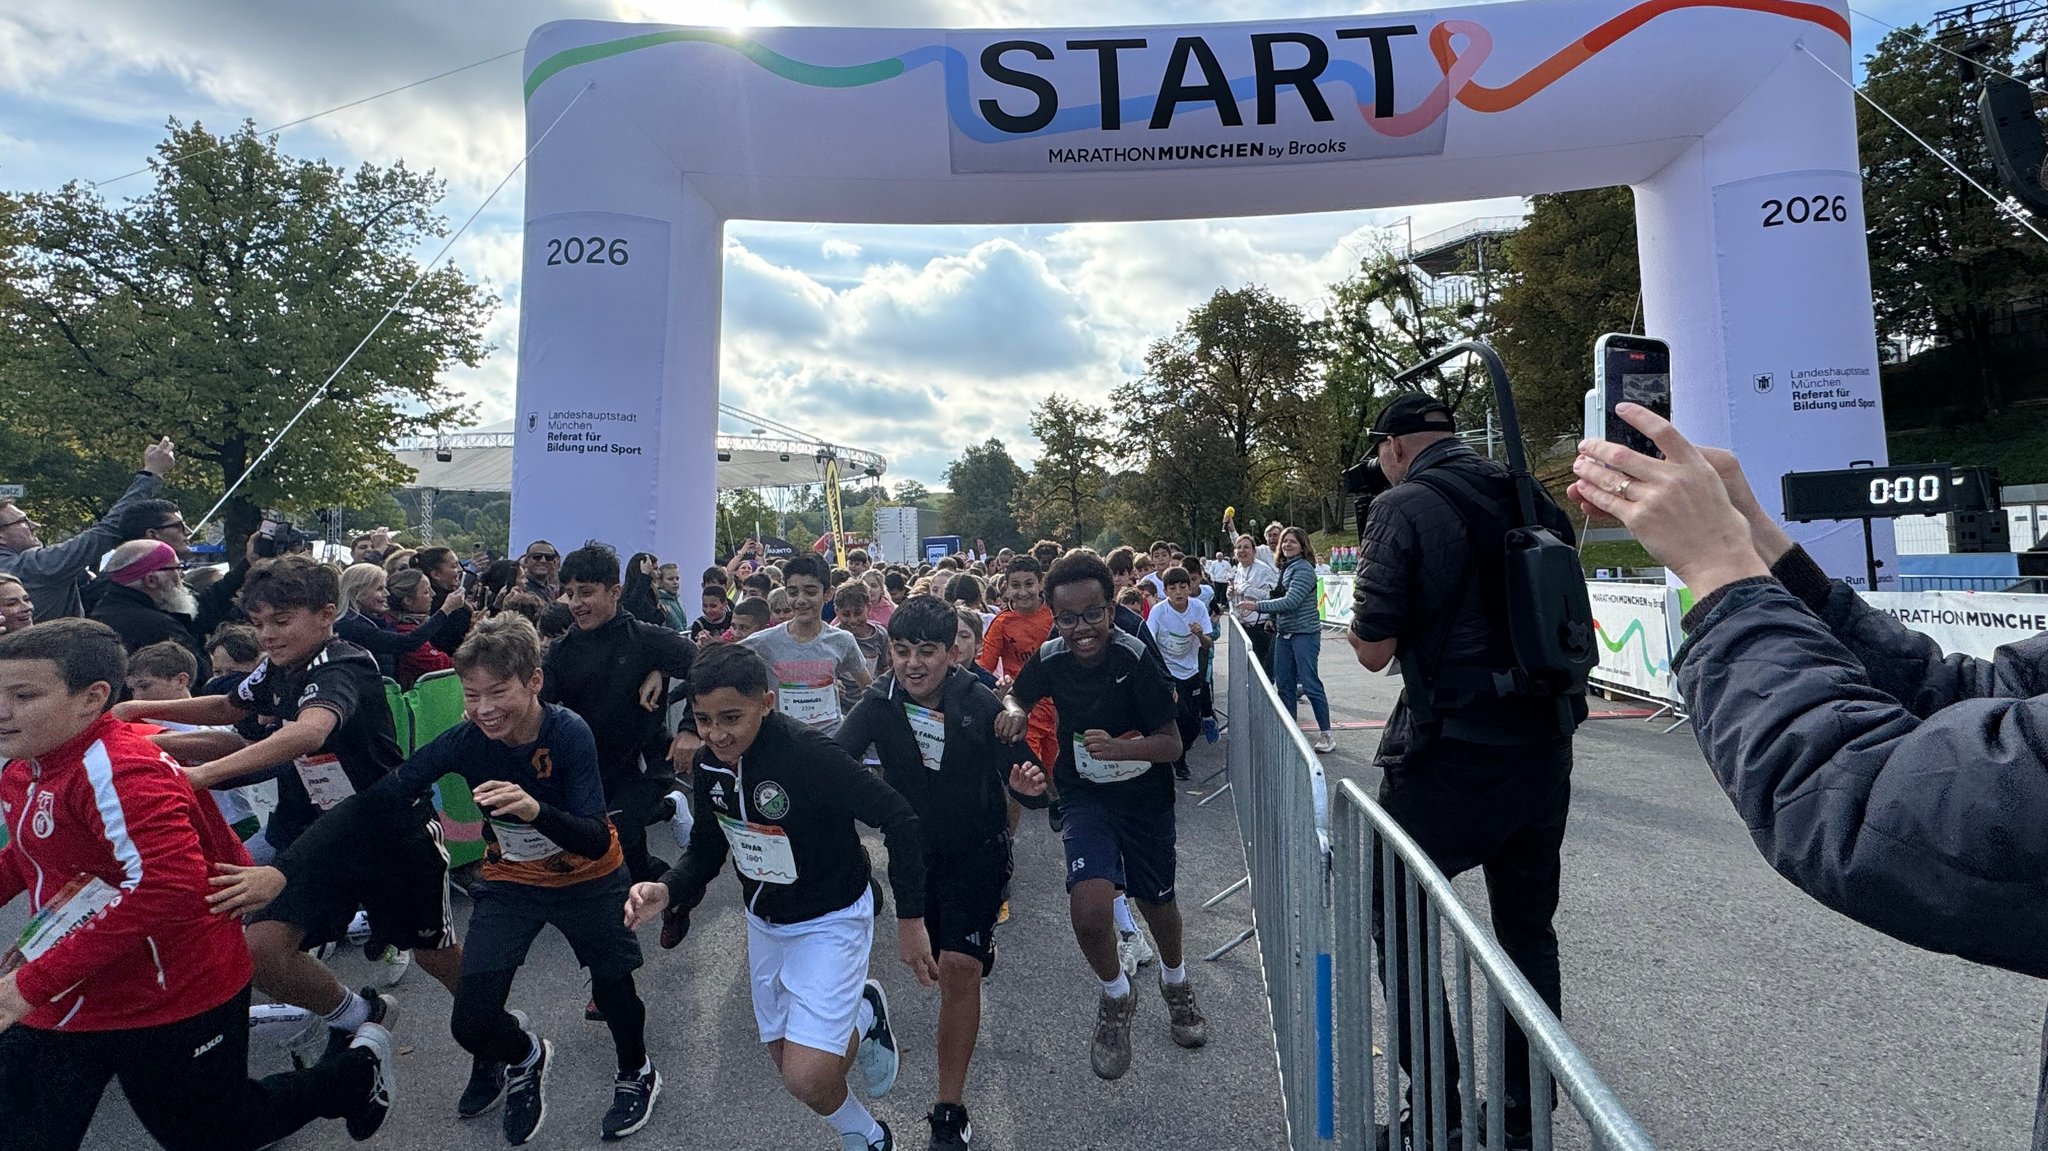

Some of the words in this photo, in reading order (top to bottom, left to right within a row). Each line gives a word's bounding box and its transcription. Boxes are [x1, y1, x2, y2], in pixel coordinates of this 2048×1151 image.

[978, 25, 1417, 133] START
[1049, 142, 1264, 163] MARATHONMÜNCHEN
[1268, 145, 1284, 158] by
[1288, 139, 1346, 156] Brooks
[1761, 195, 1847, 227] 2026
[547, 236, 629, 266] 2026
[1790, 367, 1870, 379] Landeshauptstadt
[1791, 378, 1841, 389] München
[1792, 389, 1834, 400] Referat
[1836, 388, 1850, 398] für
[1793, 400, 1838, 411] Bildung
[1839, 398, 1857, 408] und
[1858, 398, 1876, 409] Sport
[548, 410, 637, 422] Landeshauptstadt
[548, 420, 592, 430] München
[547, 432, 583, 441] Referat
[585, 432, 602, 441] für
[547, 443, 585, 454] Bildung
[587, 443, 608, 453] und
[611, 443, 642, 455] Sport
[1870, 475, 1939, 505] 0:00
[1845, 576, 1865, 585] Run
[1883, 608, 2047, 630] ARATHONMÜNCHE
[1071, 858, 1085, 872] ES
[193, 1034, 224, 1058] JAKO
